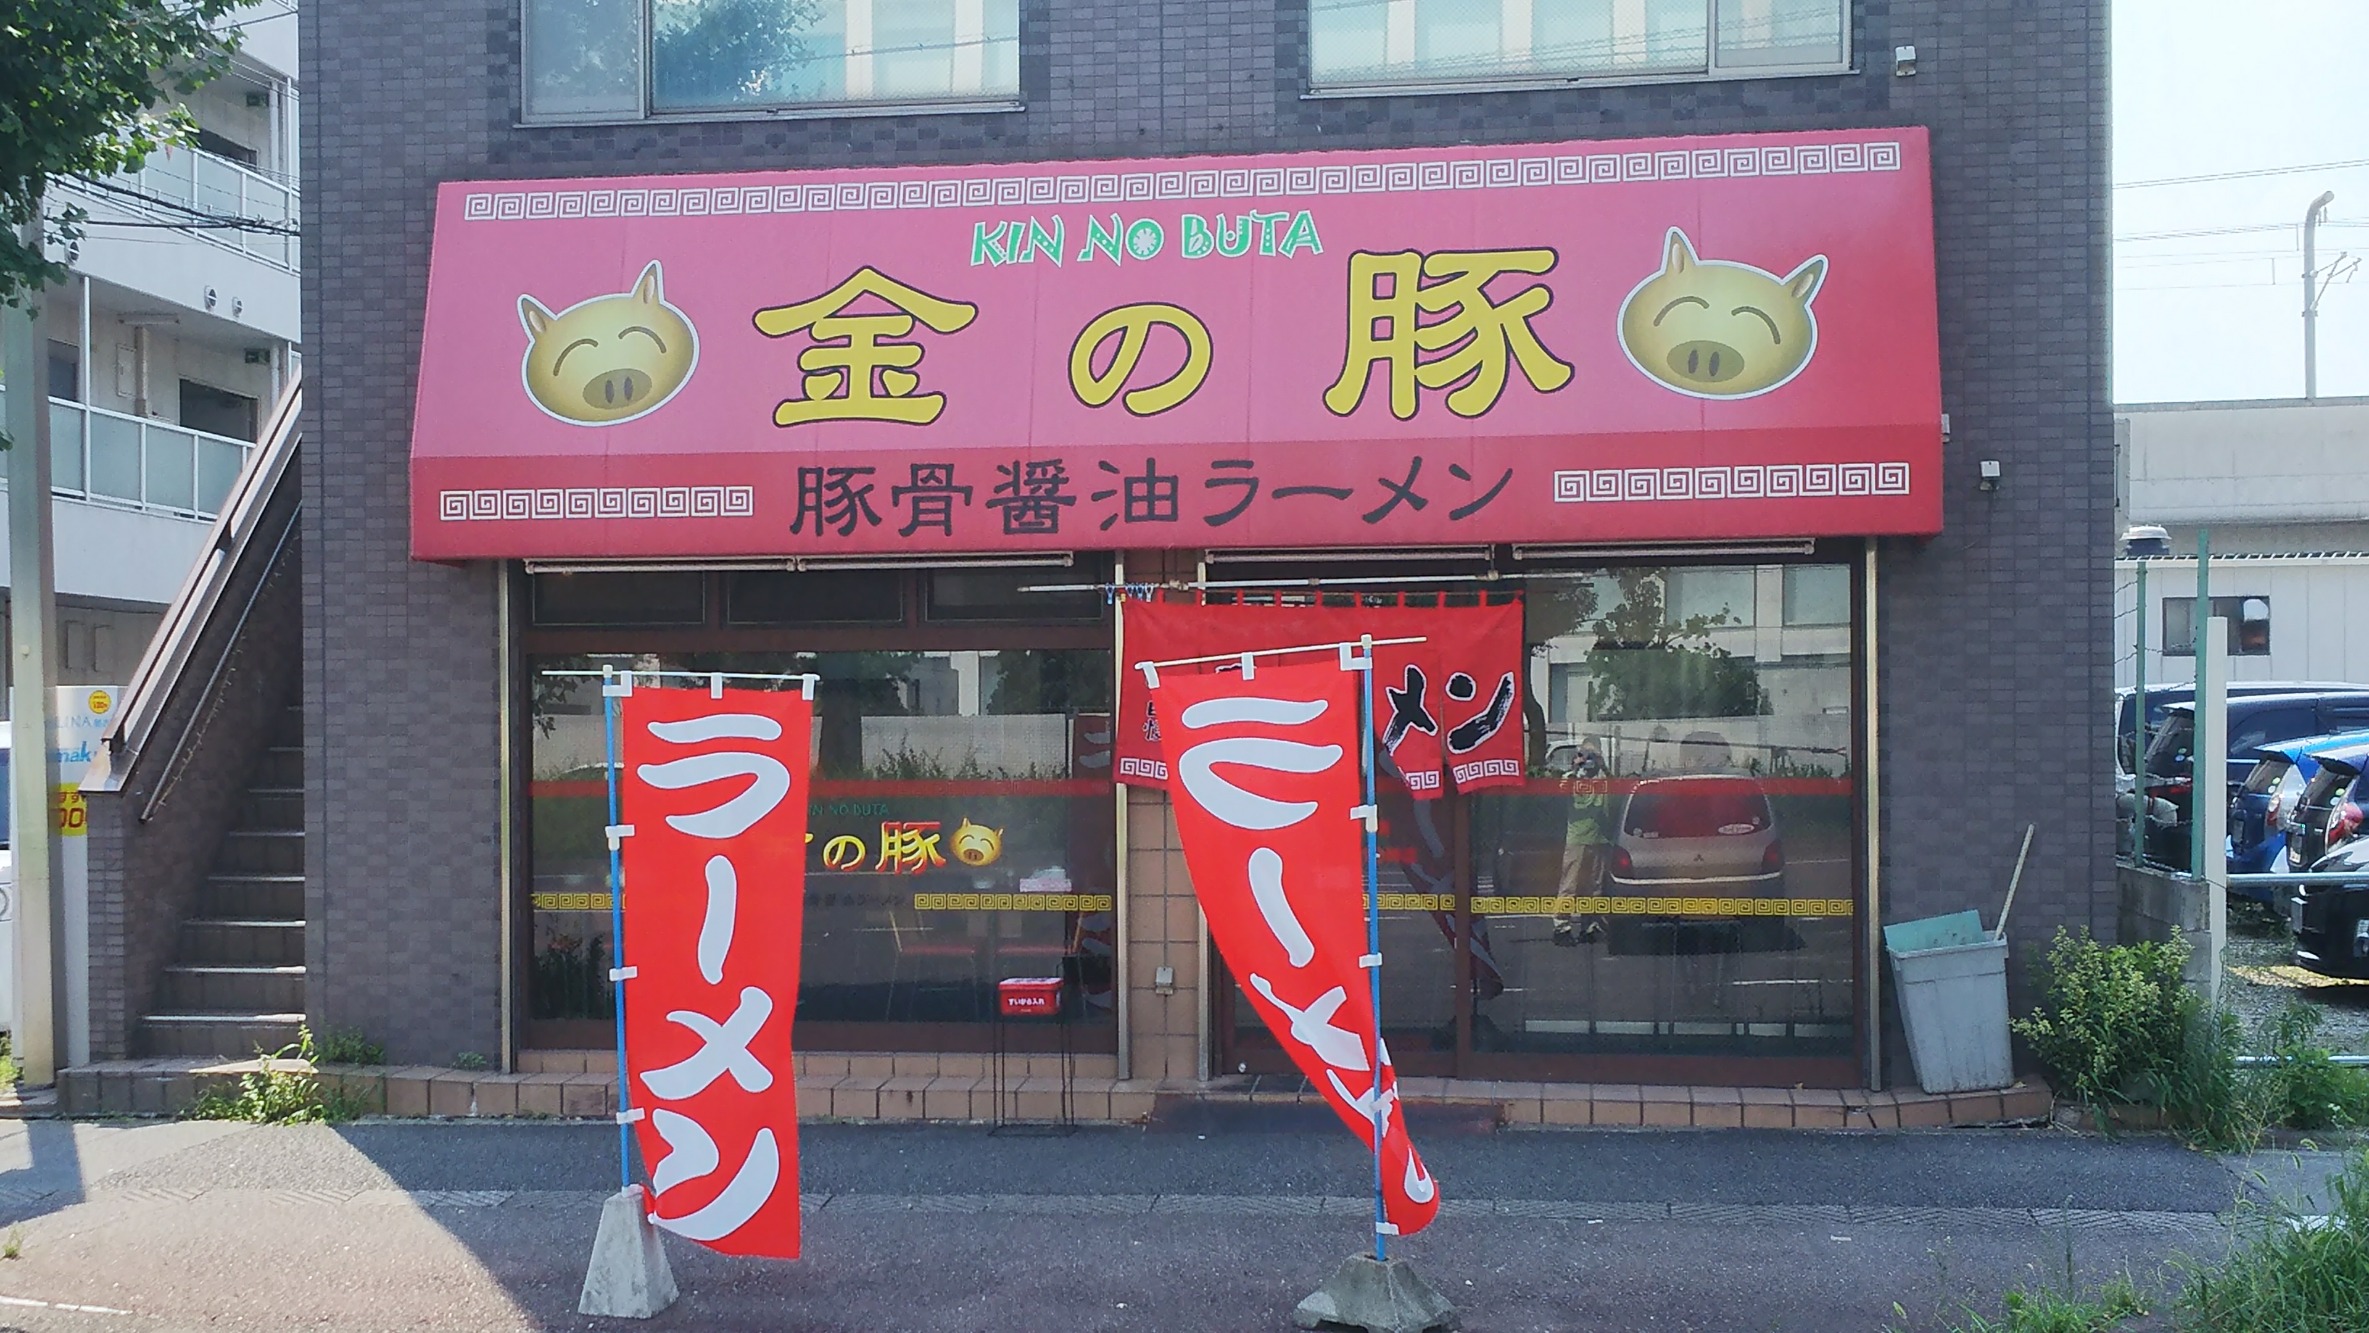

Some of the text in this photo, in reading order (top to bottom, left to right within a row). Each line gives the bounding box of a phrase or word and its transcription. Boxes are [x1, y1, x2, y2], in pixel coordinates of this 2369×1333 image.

[970, 210, 1325, 269] KIN NO BUTA
[753, 247, 1576, 428] 金の豚
[790, 457, 1514, 538] 豚骨醤油ラーメン
[804, 820, 947, 876] の豚
[636, 713, 791, 1241] ラーメン
